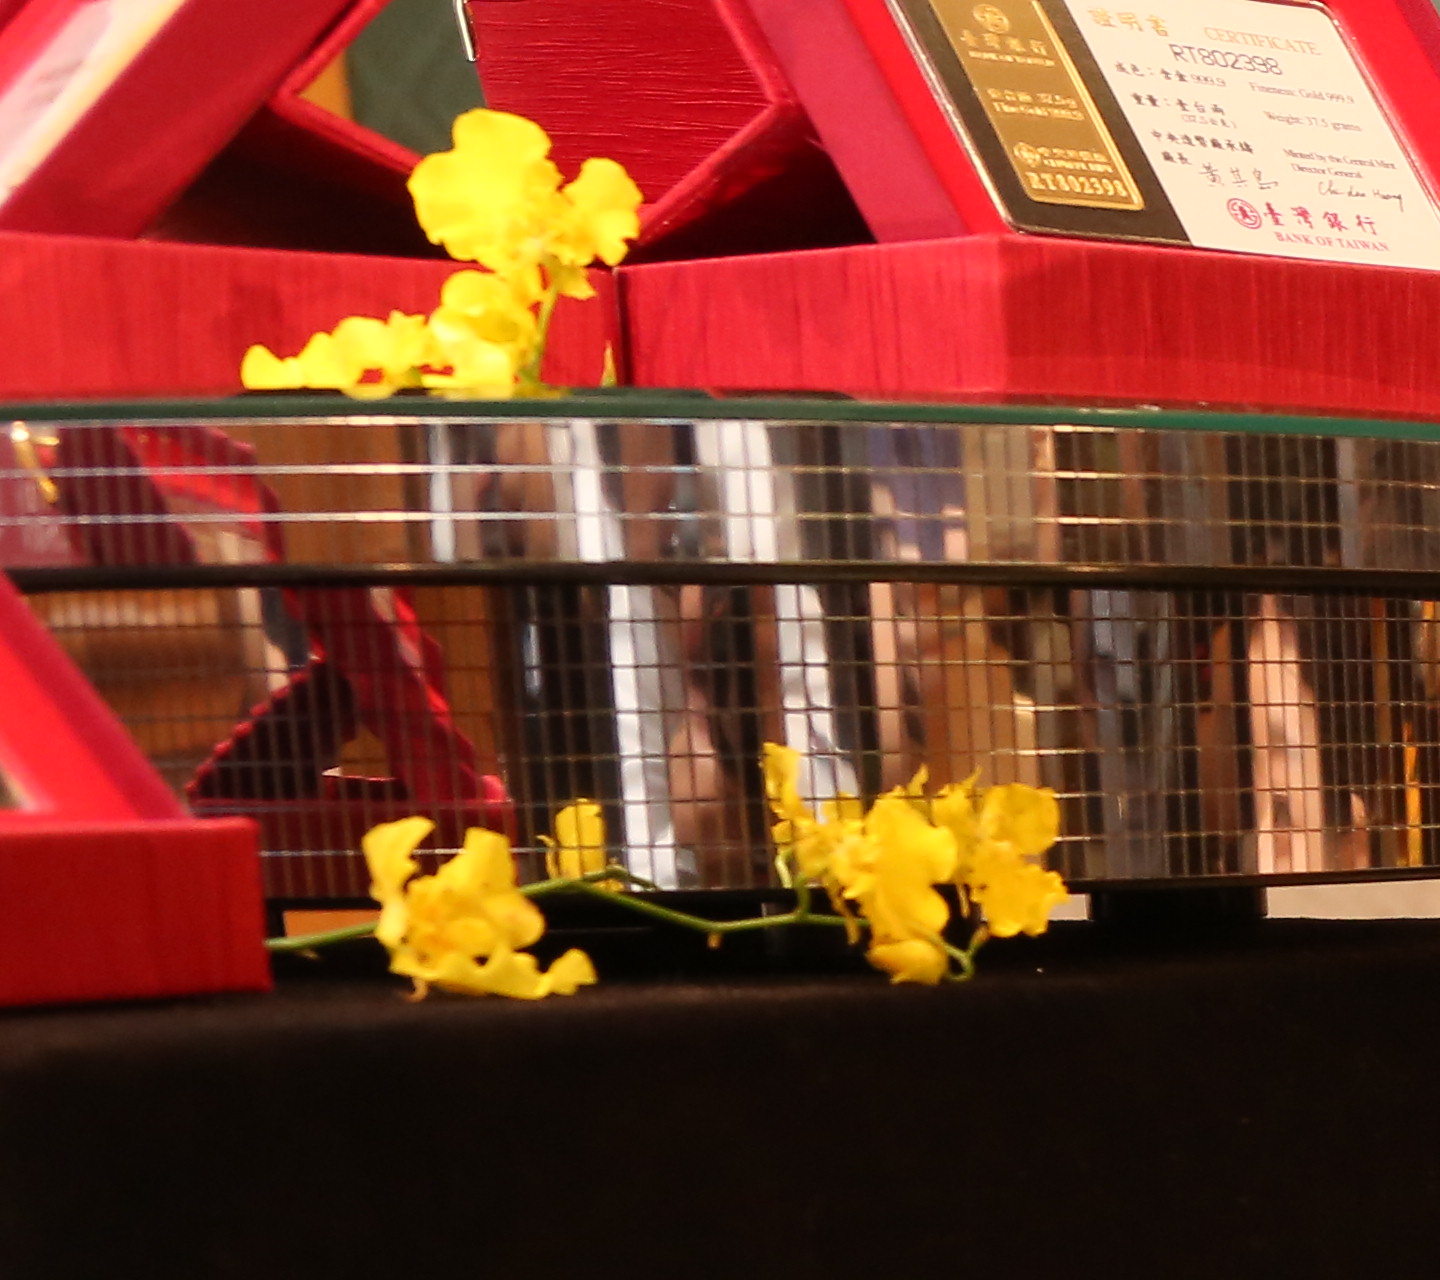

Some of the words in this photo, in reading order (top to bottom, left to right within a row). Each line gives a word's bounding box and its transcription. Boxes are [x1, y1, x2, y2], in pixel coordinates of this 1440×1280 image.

[1087, 7, 1170, 37] 證明書
[1203, 26, 1322, 56] CERTIFICATE
[1168, 43, 1283, 76] RT802398
[1305, 116, 1329, 128] 37.5
[1025, 171, 1129, 198] RT802398
[1263, 201, 1379, 236] 臺灣銀行
[1274, 231, 1313, 246] BANK
[1315, 235, 1334, 247] OF
[1335, 238, 1390, 252] TAIWAN
